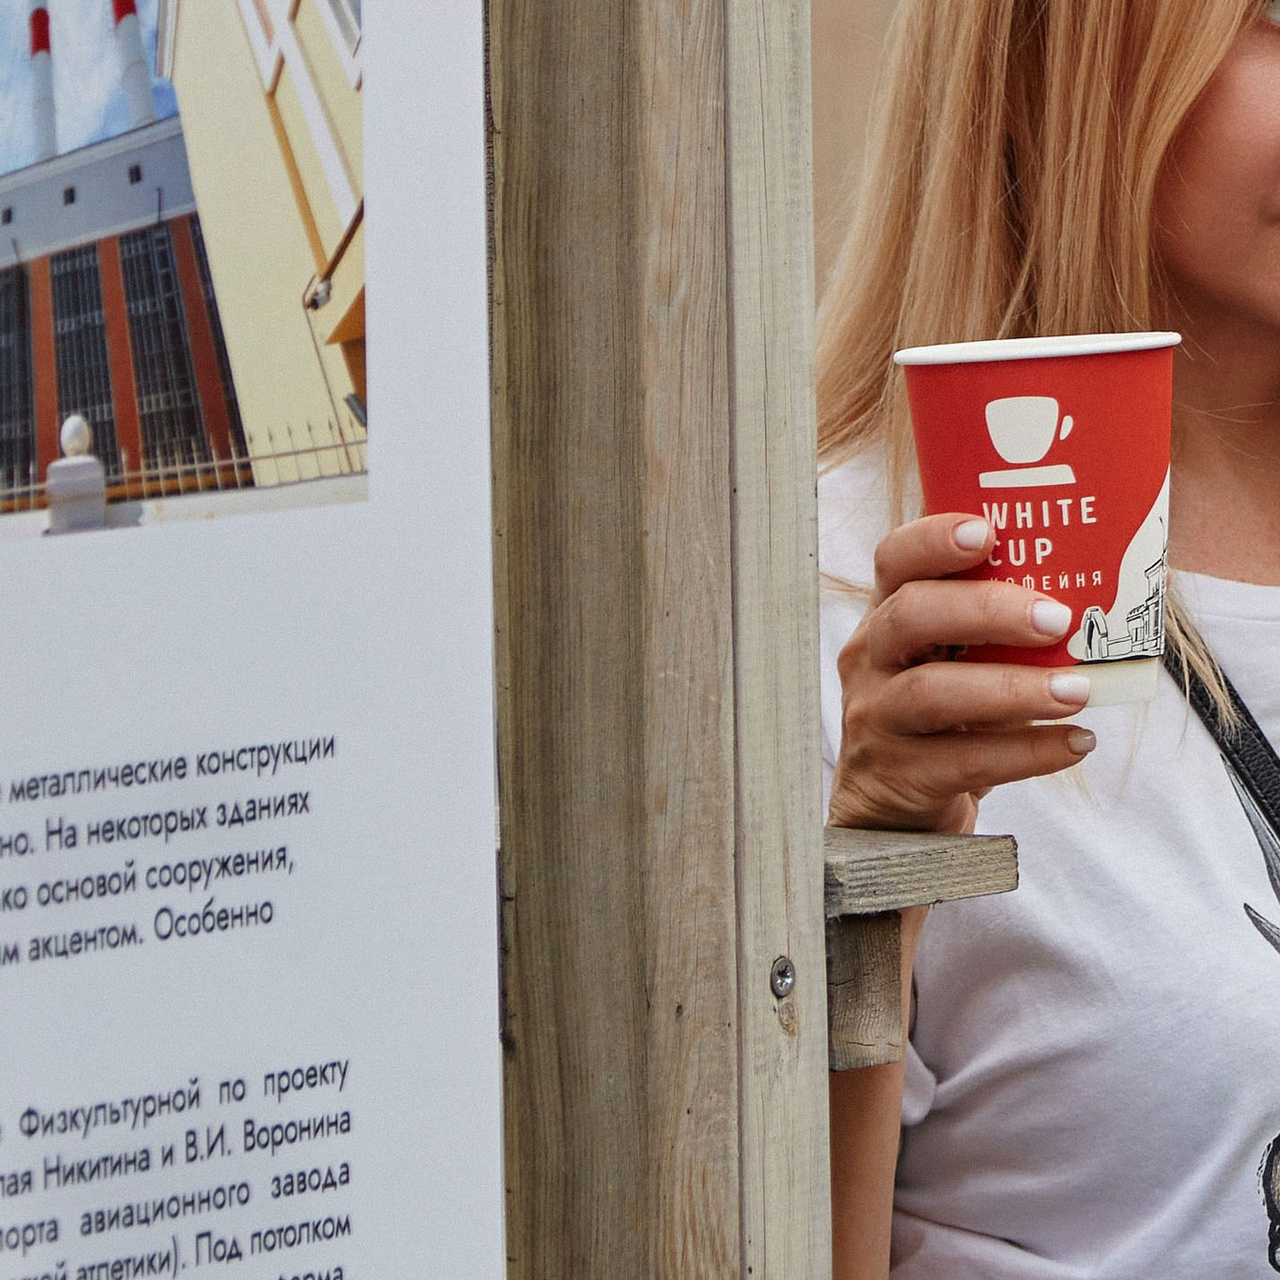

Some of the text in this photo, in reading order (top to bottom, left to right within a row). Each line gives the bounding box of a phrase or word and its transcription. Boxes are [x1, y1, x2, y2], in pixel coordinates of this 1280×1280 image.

[982, 496, 1097, 529] WHITE
[9, 734, 334, 803] металлические конструкции
[45, 816, 77, 852] На
[87, 806, 208, 846] некоторых
[216, 790, 308, 829] зданиях
[36, 858, 136, 907] основой
[145, 845, 292, 893] сооружения,
[28, 923, 142, 962] акцентом.
[154, 896, 273, 941] Особенно
[19, 1059, 348, 1140] Физкультурной по проекту
[43, 1146, 151, 1191] Никитина
[161, 1143, 174, 1169] и
[185, 1123, 231, 1164] В.И.
[243, 1110, 350, 1157] Воронина
[0, 1161, 349, 1257] орта авиационного завода
[195, 1229, 243, 1267] Под
[250, 1214, 351, 1255] потолком
